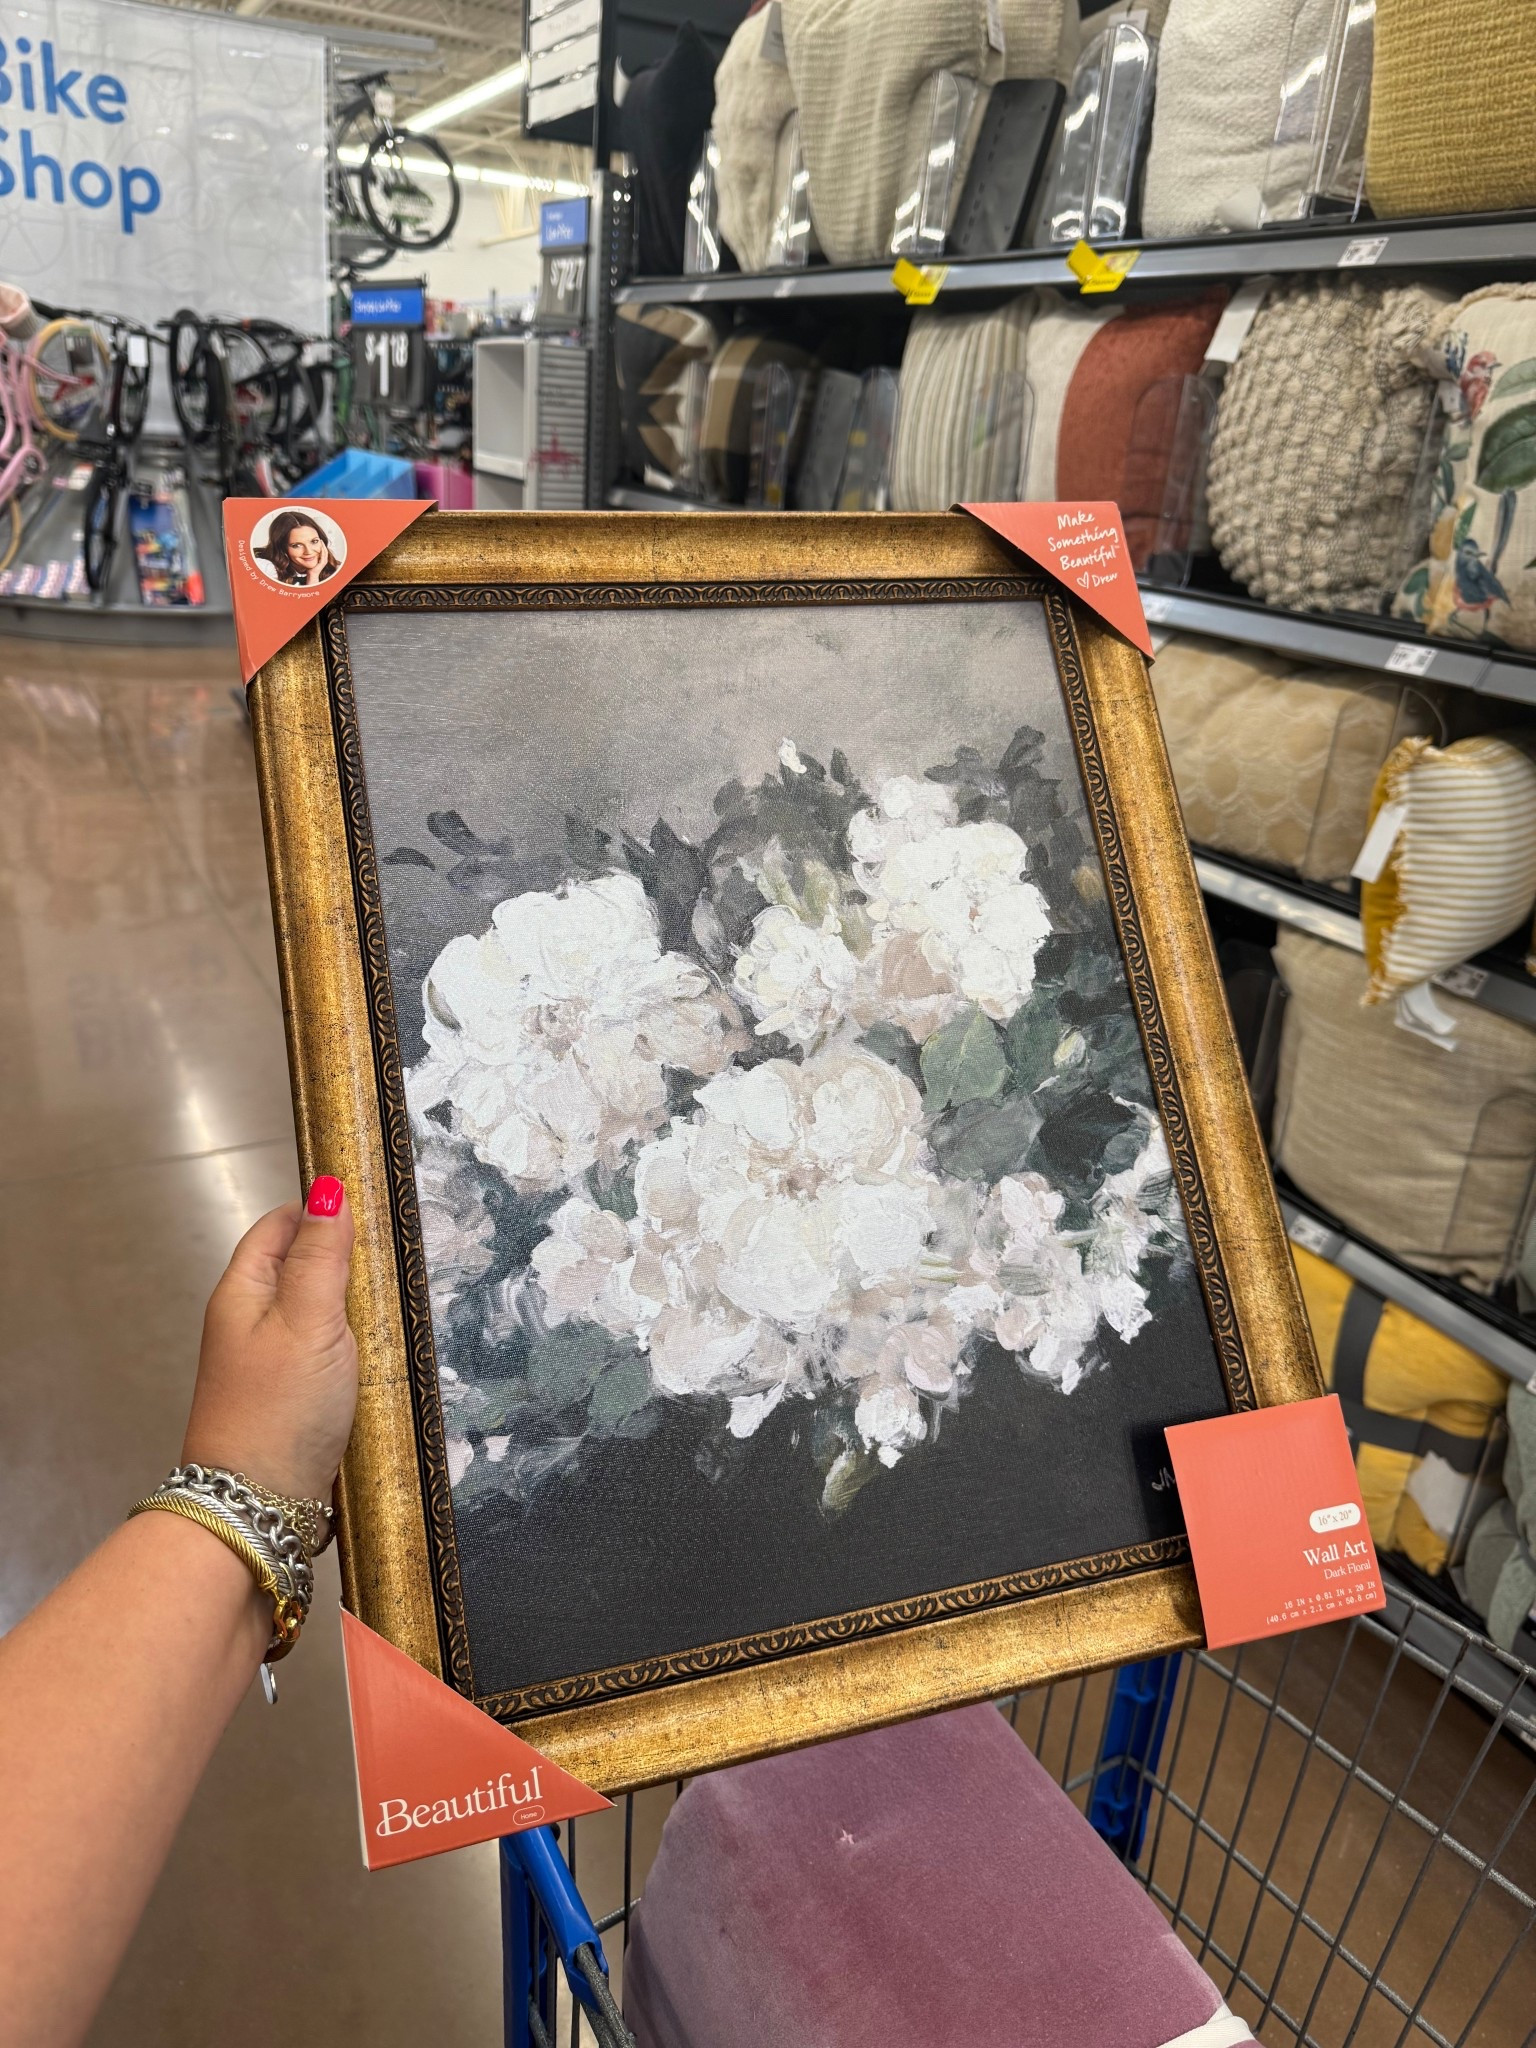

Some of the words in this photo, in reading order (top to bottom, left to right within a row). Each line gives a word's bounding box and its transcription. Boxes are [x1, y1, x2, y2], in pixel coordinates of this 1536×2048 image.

[1057, 510, 1095, 530] Make
[1048, 526, 1119, 552] Something
[1060, 545, 1117, 571] Beautiful
[238, 540, 253, 571] Designed
[250, 571, 260, 581] by
[260, 579, 277, 592] Drew
[278, 588, 320, 600] Barrymore
[1092, 572, 1118, 587] Drew
[1332, 1515, 1338, 1523] x
[1303, 1544, 1340, 1566] Wall
[1343, 1540, 1368, 1558] Art
[1324, 1565, 1347, 1580] Dark
[1347, 1559, 1371, 1574] Floral
[1284, 1600, 1293, 1610] 16
[1296, 1598, 1305, 1607] IN
[1336, 1588, 1345, 1596] IN
[1355, 1584, 1364, 1592] 20
[1367, 1581, 1376, 1589] IN
[1310, 1604, 1323, 1613] 2.1
[375, 1766, 543, 1837] Beautiful
[520, 1811, 538, 1820] Home
